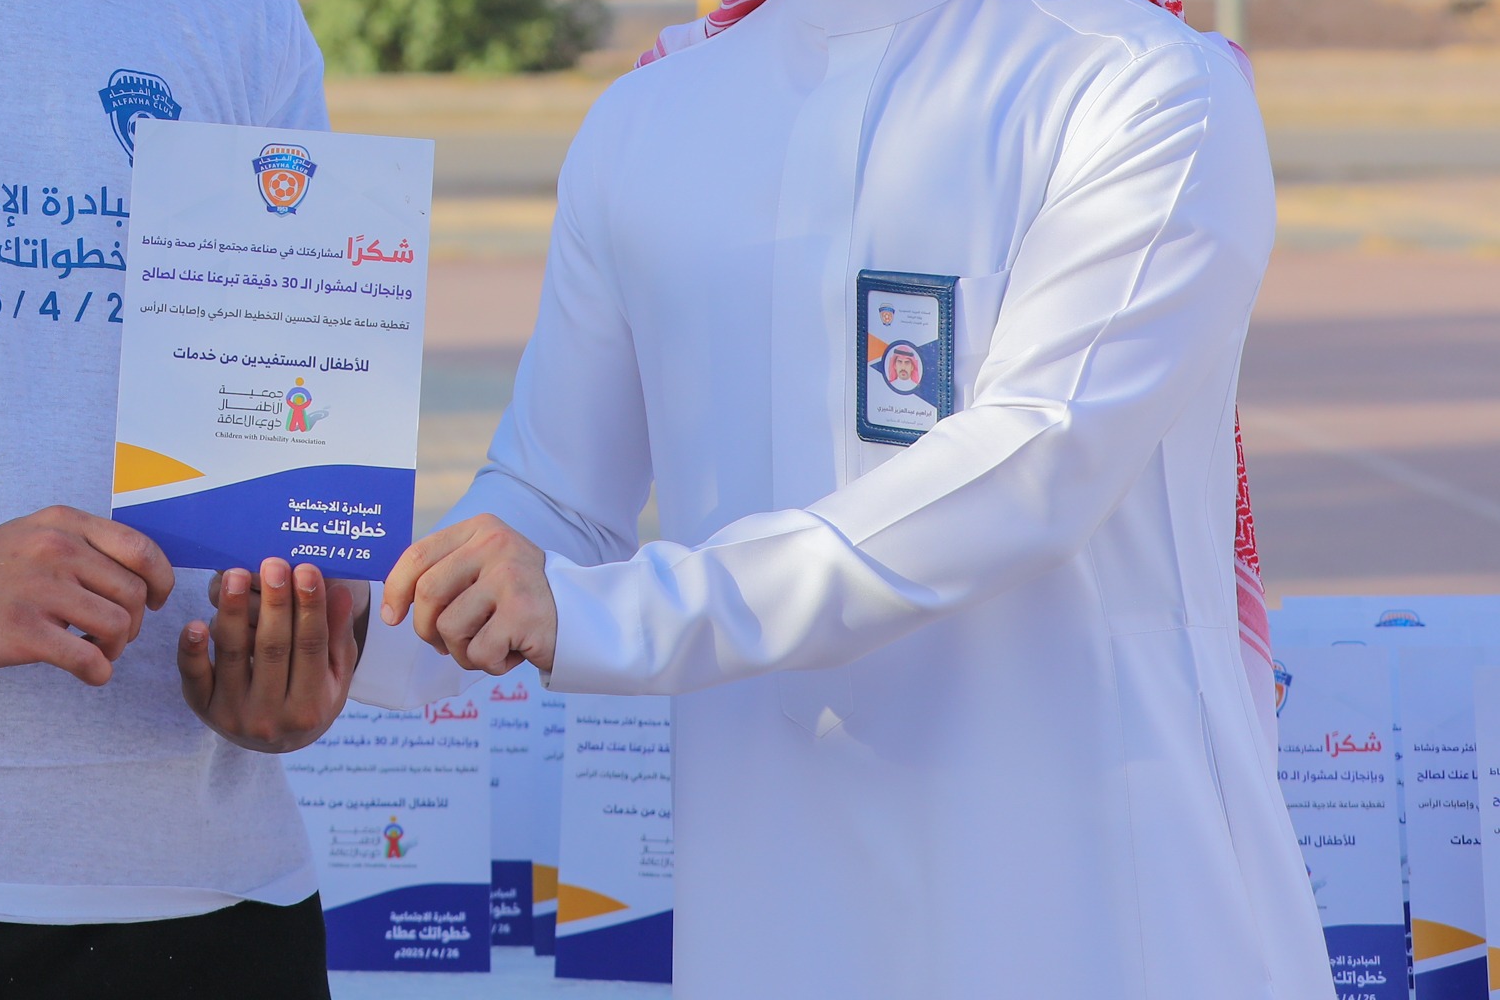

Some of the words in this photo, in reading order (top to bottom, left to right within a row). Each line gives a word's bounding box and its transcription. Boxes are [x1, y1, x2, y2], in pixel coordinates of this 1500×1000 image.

[109, 87, 151, 99] الفيحاء
[112, 97, 150, 108] ALFAYHA
[152, 101, 173, 118] CLUB
[152, 94, 175, 109] نادي
[260, 162, 290, 171] ALFAYHA
[291, 164, 309, 174] CLUB
[41, 185, 131, 228] بادرة
[141, 235, 173, 249] ونشاط
[175, 238, 196, 248] صحة
[197, 238, 217, 251] أكثر
[218, 242, 248, 254] مجتمع
[250, 243, 278, 254] صناعة
[279, 245, 294, 260] في
[296, 246, 344, 260] لمشاركتك
[347, 234, 414, 267] شكرًا
[141, 266, 176, 282] لصالح
[178, 268, 204, 282] عنك
[207, 270, 240, 287] تبرعنا
[242, 273, 278, 290] دقيقة
[281, 276, 299, 289] 30
[314, 279, 358, 294] لمشوار
[360, 282, 413, 301] وبإنجازك
[38, 290, 61, 322] 4
[106, 292, 124, 323] 2
[139, 301, 167, 314] الرأس
[168, 304, 206, 318] وإصابات
[207, 307, 242, 321] الحركي
[244, 309, 283, 322] التخطيط
[284, 314, 321, 325] لتحسين
[322, 315, 352, 327] علاجية
[353, 317, 378, 328] ساعة
[380, 319, 410, 332] تغطية
[172, 346, 217, 361] خدمات
[219, 353, 238, 365] من
[241, 353, 316, 369] المستفيدين
[319, 356, 370, 373] للأطفال
[215, 431, 243, 440] Children
[244, 433, 258, 441] with
[259, 434, 289, 443] Disability
[290, 436, 326, 446] Association
[288, 498, 340, 513] الاجتماعية
[341, 501, 382, 517] المبادرة
[280, 515, 320, 533] عطاء
[322, 519, 387, 540] خطواتك
[337, 547, 346, 558] 4
[355, 548, 371, 560] 26
